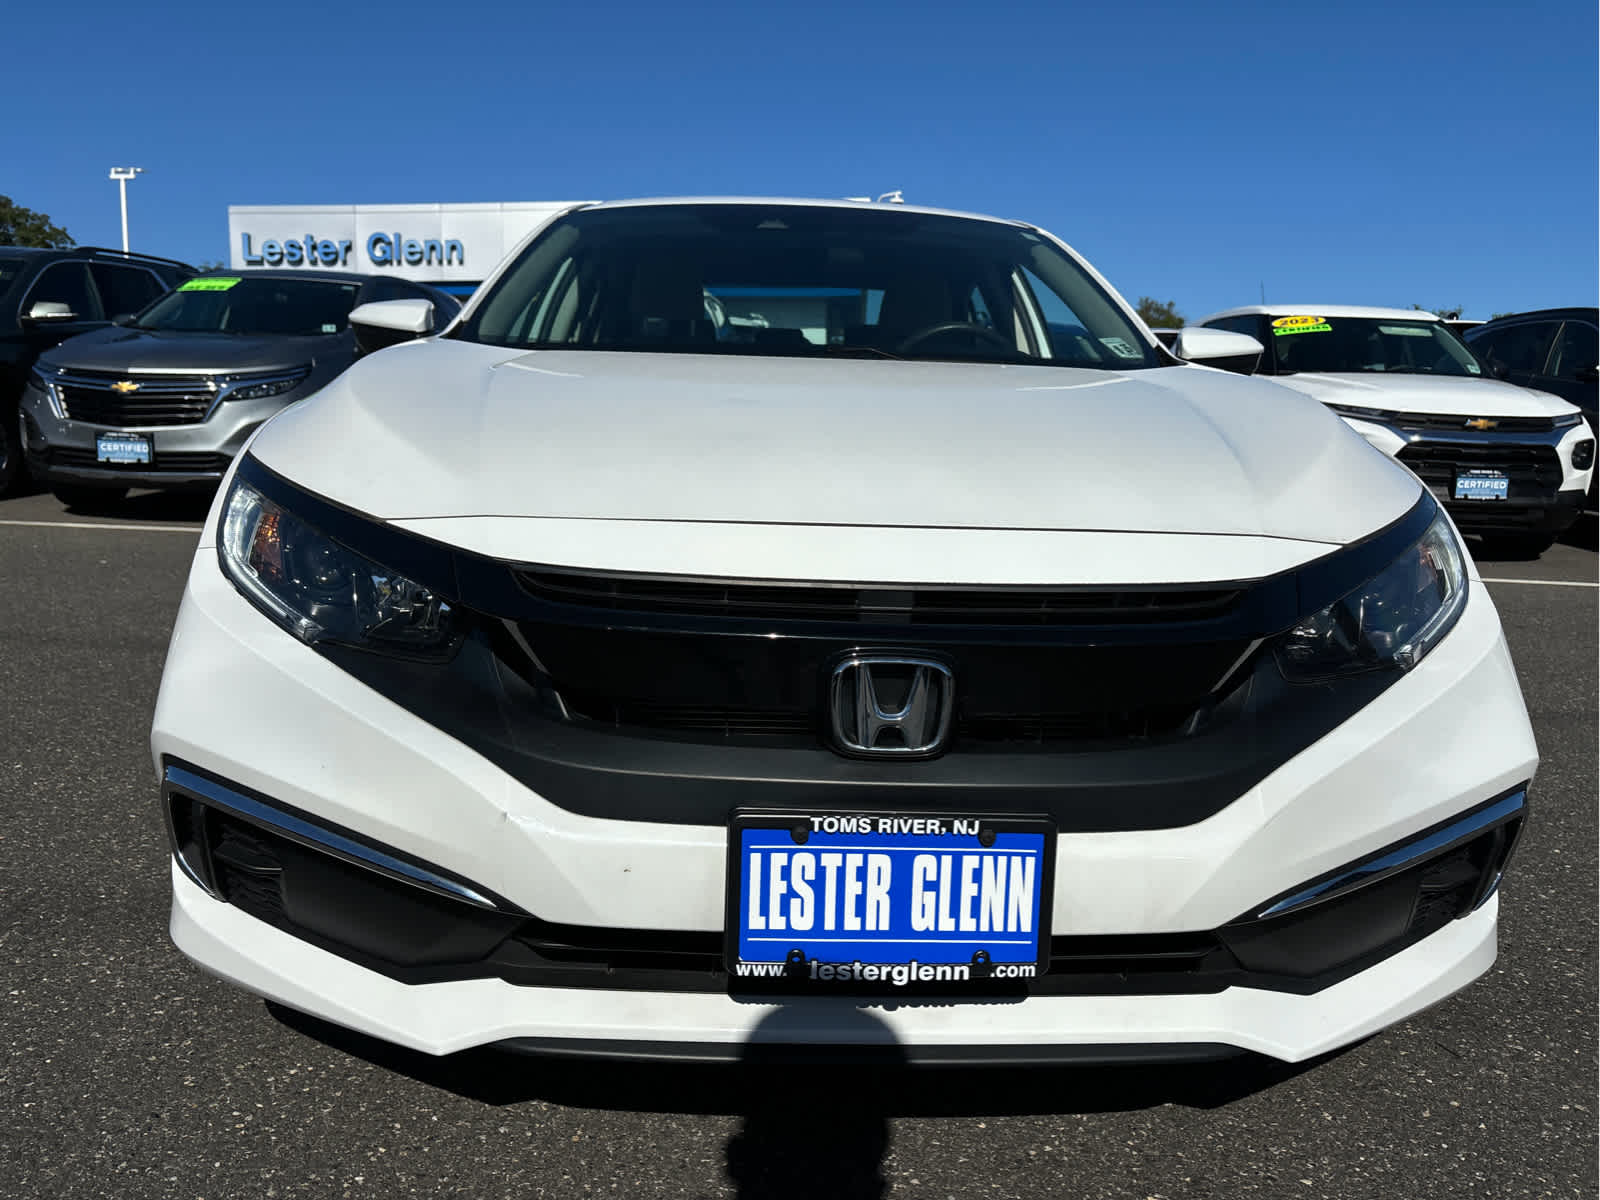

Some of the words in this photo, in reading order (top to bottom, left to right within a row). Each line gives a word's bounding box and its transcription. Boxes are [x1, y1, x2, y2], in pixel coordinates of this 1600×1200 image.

[241, 232, 352, 267] Lester
[366, 232, 464, 267] Glenn
[99, 442, 149, 452] CERTIFIED
[1456, 480, 1507, 489] CERTIFIED
[810, 817, 871, 834] TOMS
[877, 819, 946, 836] RIVER,
[952, 820, 980, 836] NJ
[748, 852, 892, 931] LESTER
[910, 854, 1036, 933] GLENN
[809, 960, 969, 986] lesterglenn
[990, 964, 1036, 977] .com
